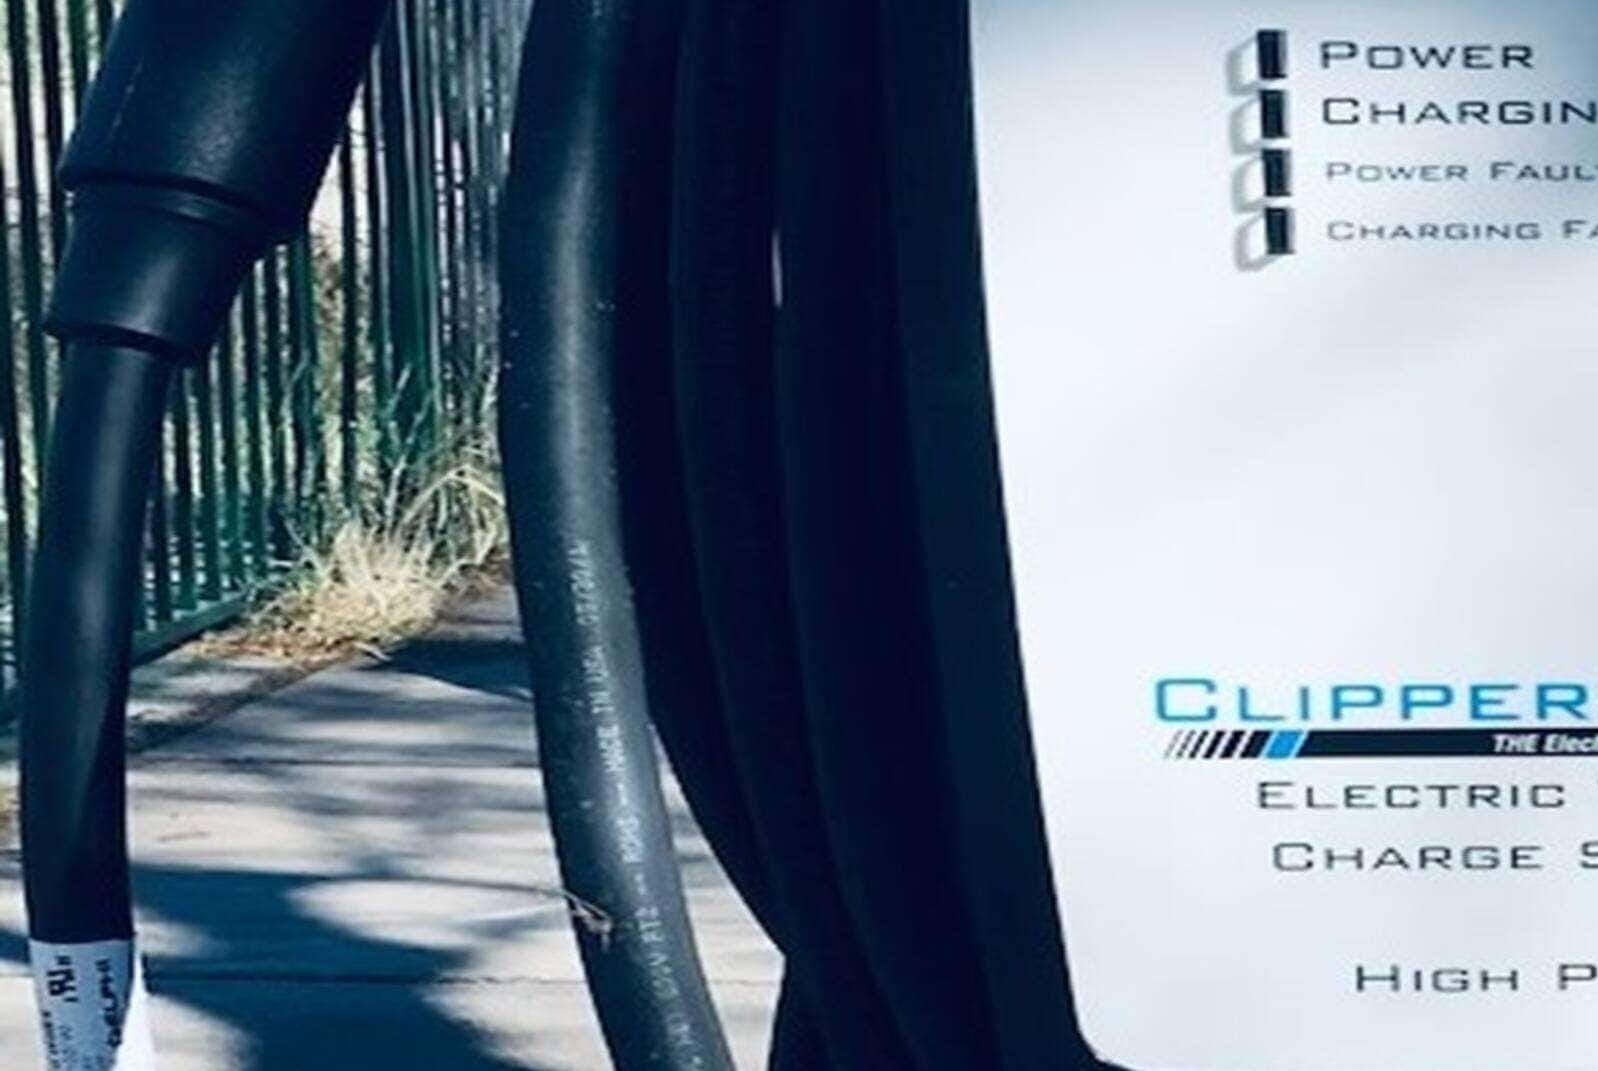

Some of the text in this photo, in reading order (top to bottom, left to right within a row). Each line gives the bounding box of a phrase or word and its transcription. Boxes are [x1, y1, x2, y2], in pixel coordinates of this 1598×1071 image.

[1320, 40, 1535, 69] POWER
[1326, 162, 1468, 183] POWER
[1326, 221, 1542, 241] CHARGING
[1494, 736, 1542, 753] THE
[1256, 781, 1566, 810] ELECTRIC
[1272, 842, 1543, 872] CHARGE
[1355, 964, 1520, 993] HIGH
